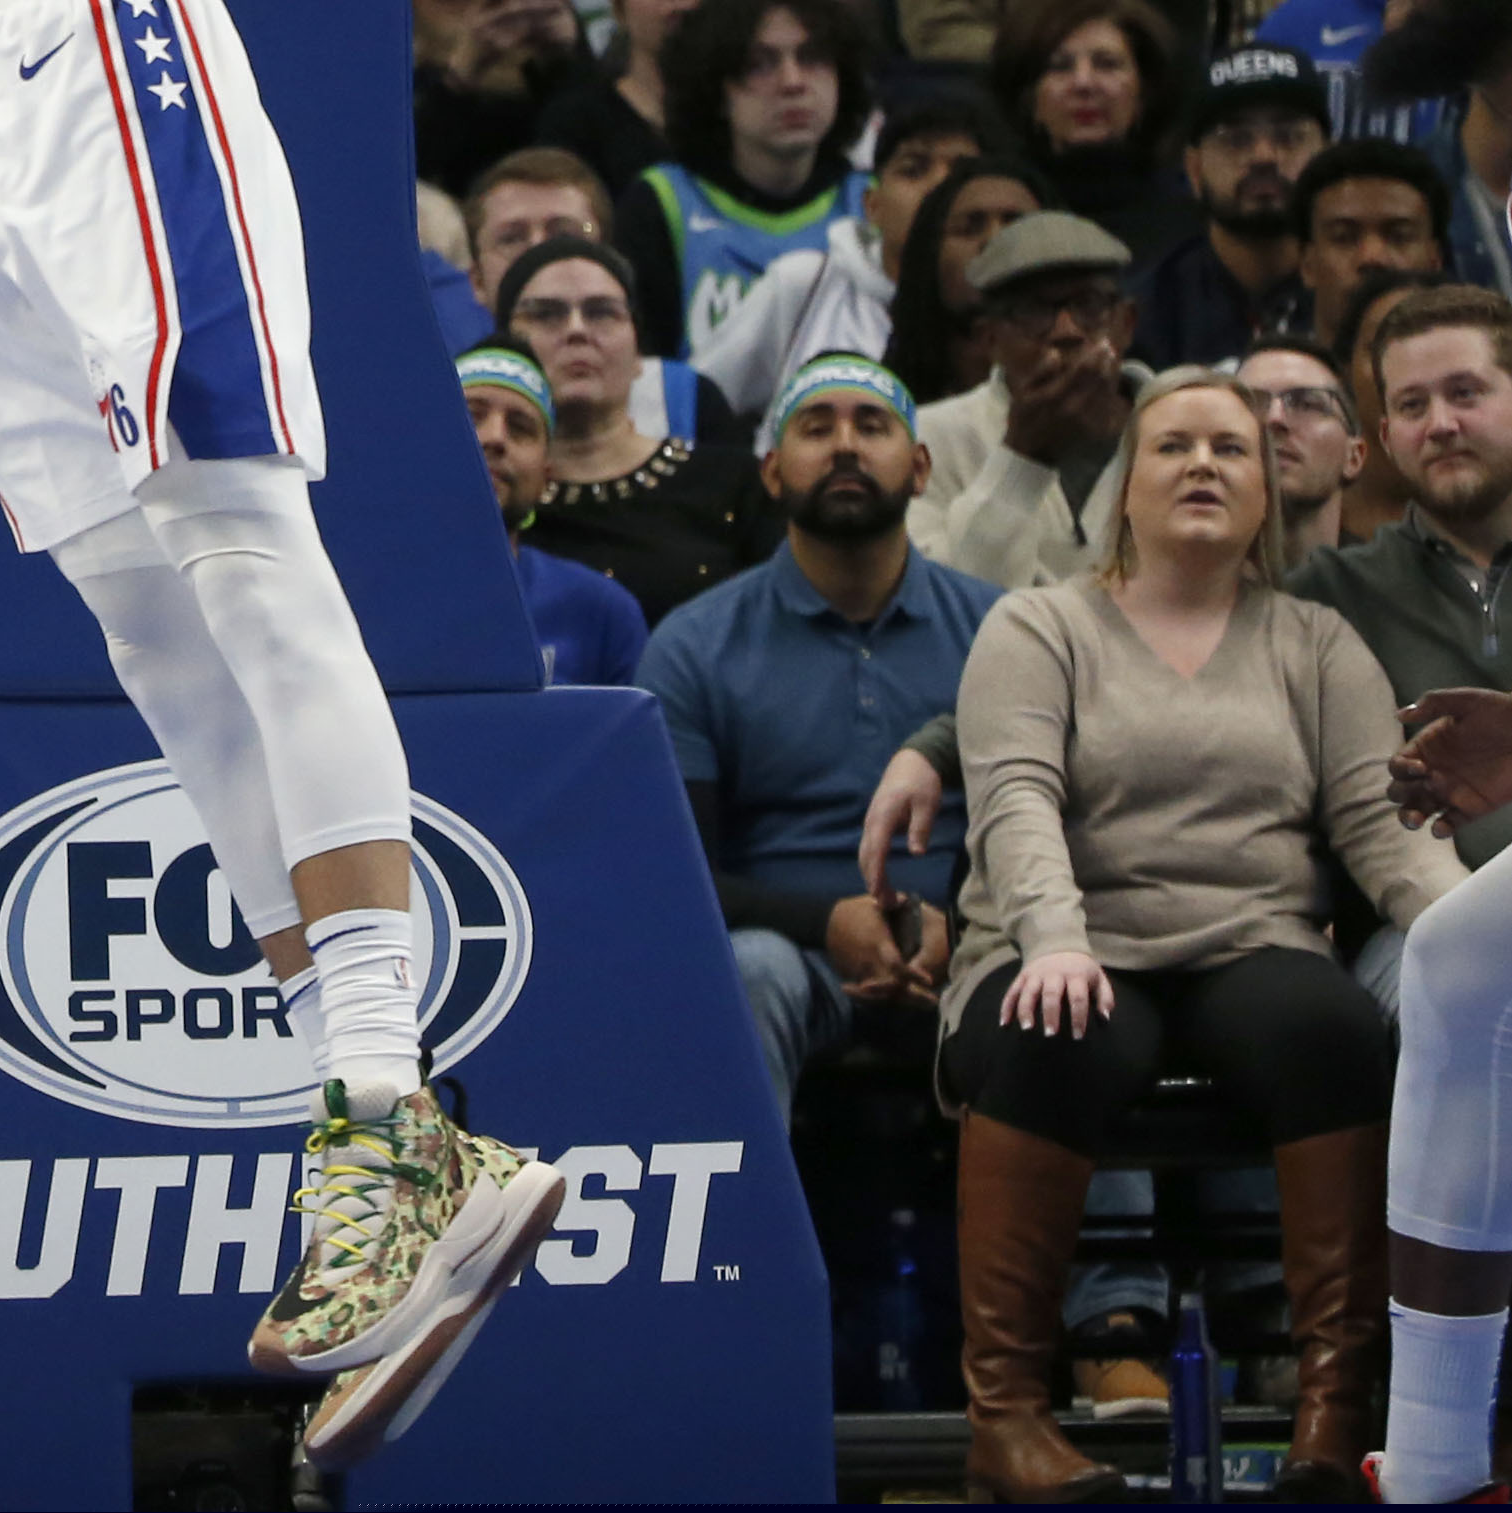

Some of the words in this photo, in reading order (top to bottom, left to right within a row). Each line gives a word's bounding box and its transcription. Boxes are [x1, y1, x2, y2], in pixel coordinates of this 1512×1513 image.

[1209, 49, 1298, 86] QUEENS
[67, 840, 273, 981] FO
[68, 986, 294, 1042] SPOR
[713, 1265, 740, 1281] TM
